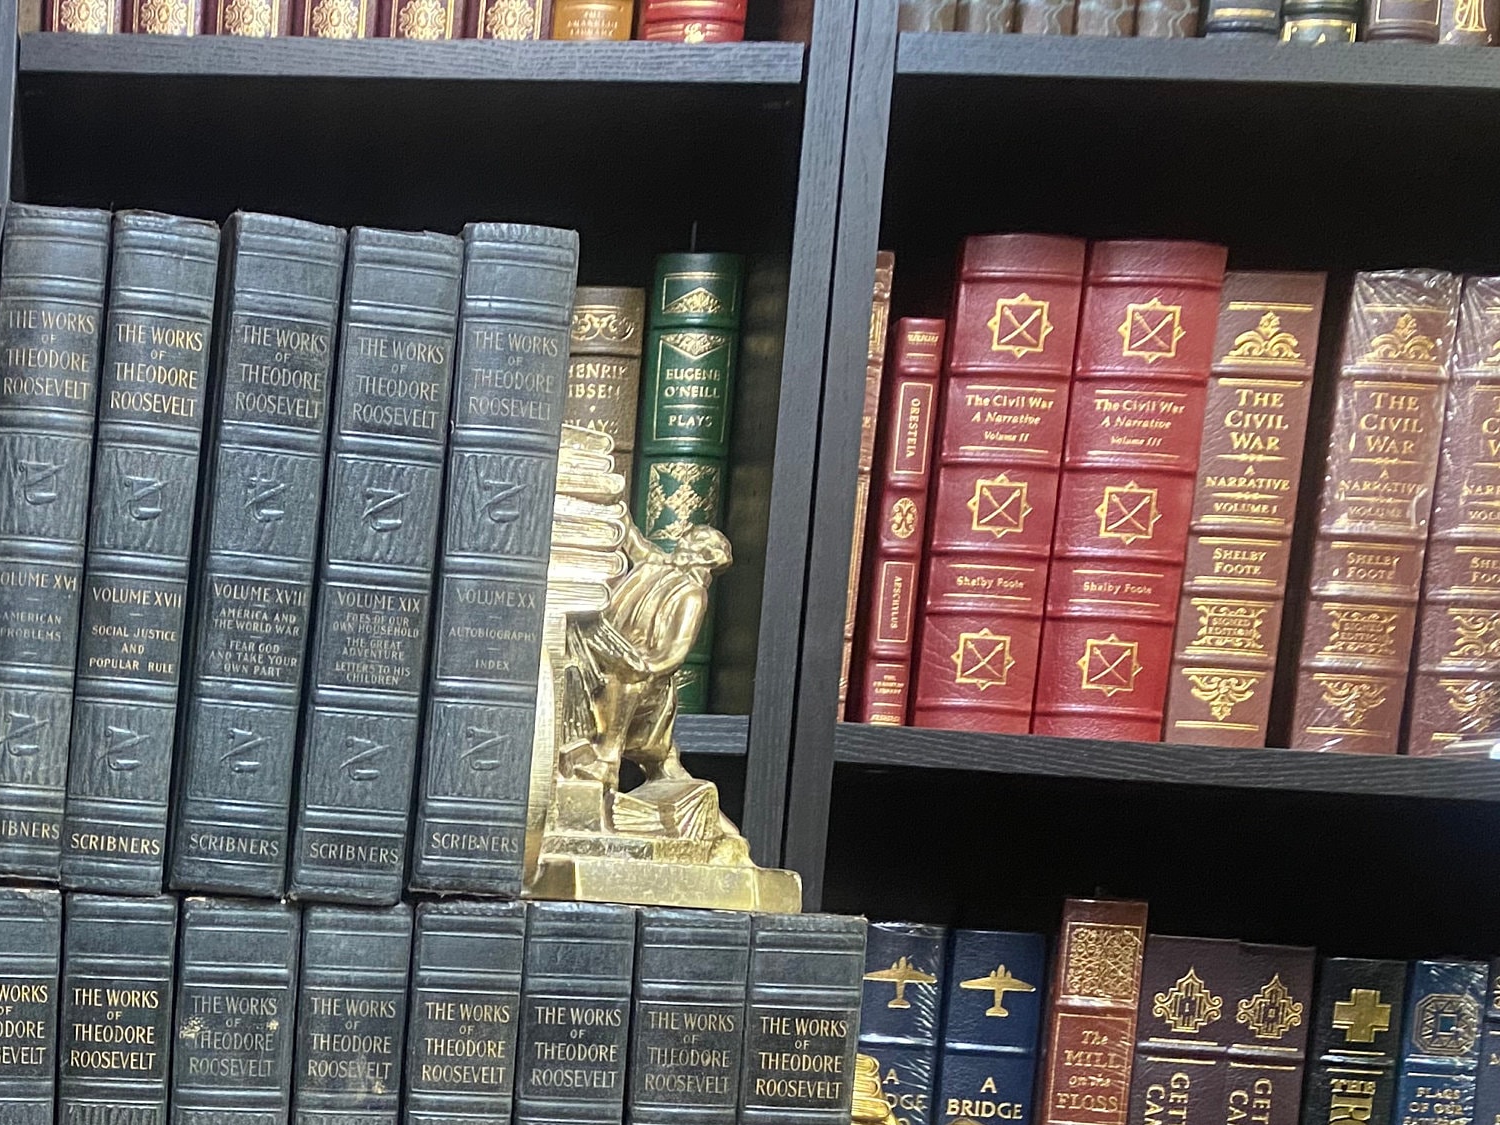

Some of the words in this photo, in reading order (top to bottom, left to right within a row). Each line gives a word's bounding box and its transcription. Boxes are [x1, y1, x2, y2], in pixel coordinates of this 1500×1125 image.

[116, 322, 146, 344] THE
[150, 325, 203, 352] WORKS
[150, 349, 167, 361] OF
[114, 361, 198, 390] THEODORE
[665, 367, 721, 382] EUGENE
[664, 385, 720, 399] O'NEILL
[1235, 388, 1285, 409] THE
[110, 390, 197, 418] ROOSEVELT
[965, 394, 992, 407] The
[994, 394, 1026, 408] Civil
[1028, 395, 1054, 409] War
[1094, 399, 1120, 413] The
[1122, 400, 1155, 414] Civil
[1158, 401, 1186, 414] War
[1369, 392, 1420, 412] THE
[668, 414, 713, 428] PLAYS
[905, 397, 921, 458] ORESTEIA
[971, 413, 981, 423] A
[985, 413, 1042, 426] Narrative
[1101, 417, 1111, 427] A
[1114, 417, 1172, 430] Narrative
[1224, 410, 1289, 431] CIVIL
[1358, 413, 1424, 434] CIVIL
[984, 431, 1016, 442] Volume
[1019, 432, 1030, 442] II
[1110, 435, 1145, 446] Volume
[1229, 431, 1281, 452] WAR
[1365, 435, 1415, 454] WAR
[1244, 464, 1256, 476] A
[1205, 476, 1291, 491] NARRATIVE
[1213, 502, 1270, 514] VOLUME
[1212, 547, 1267, 561] SHELBY
[1346, 551, 1400, 567] SHELBY
[1213, 561, 1262, 575] FOOTE
[1346, 566, 1396, 580] FOOTE
[956, 575, 994, 590] Shelby
[997, 576, 1025, 589] Foote
[1083, 581, 1121, 595] Shelby
[1123, 582, 1152, 595] Foote
[92, 586, 151, 606] VOLUME
[153, 590, 182, 609] XVII
[890, 575, 903, 629] AESCHYLUS
[91, 625, 129, 639] SOCIAL
[132, 627, 177, 642] JUSTICE
[121, 643, 145, 655] AND
[88, 657, 142, 672] POPULAR
[147, 660, 175, 674] RULE
[70, 832, 161, 856] SCRIBNERS
[760, 1016, 790, 1036] THE
[794, 1018, 847, 1039] WORKS
[794, 1039, 810, 1050] OF
[1081, 1030, 1108, 1046] The
[758, 1052, 843, 1074] THEODORE
[1063, 1049, 1122, 1070] MILL
[979, 1076, 998, 1094] A
[1068, 1076, 1089, 1088] on
[1090, 1073, 1112, 1088] the
[1330, 1078, 1377, 1096] THE
[755, 1078, 843, 1100] ROOSEVELT
[1415, 1087, 1462, 1100] FLAGS
[946, 1098, 1024, 1120] BRIDGE
[1056, 1092, 1119, 1113] FLOSS
[1409, 1102, 1429, 1113] OF
[1432, 1102, 1464, 1116] OUR
